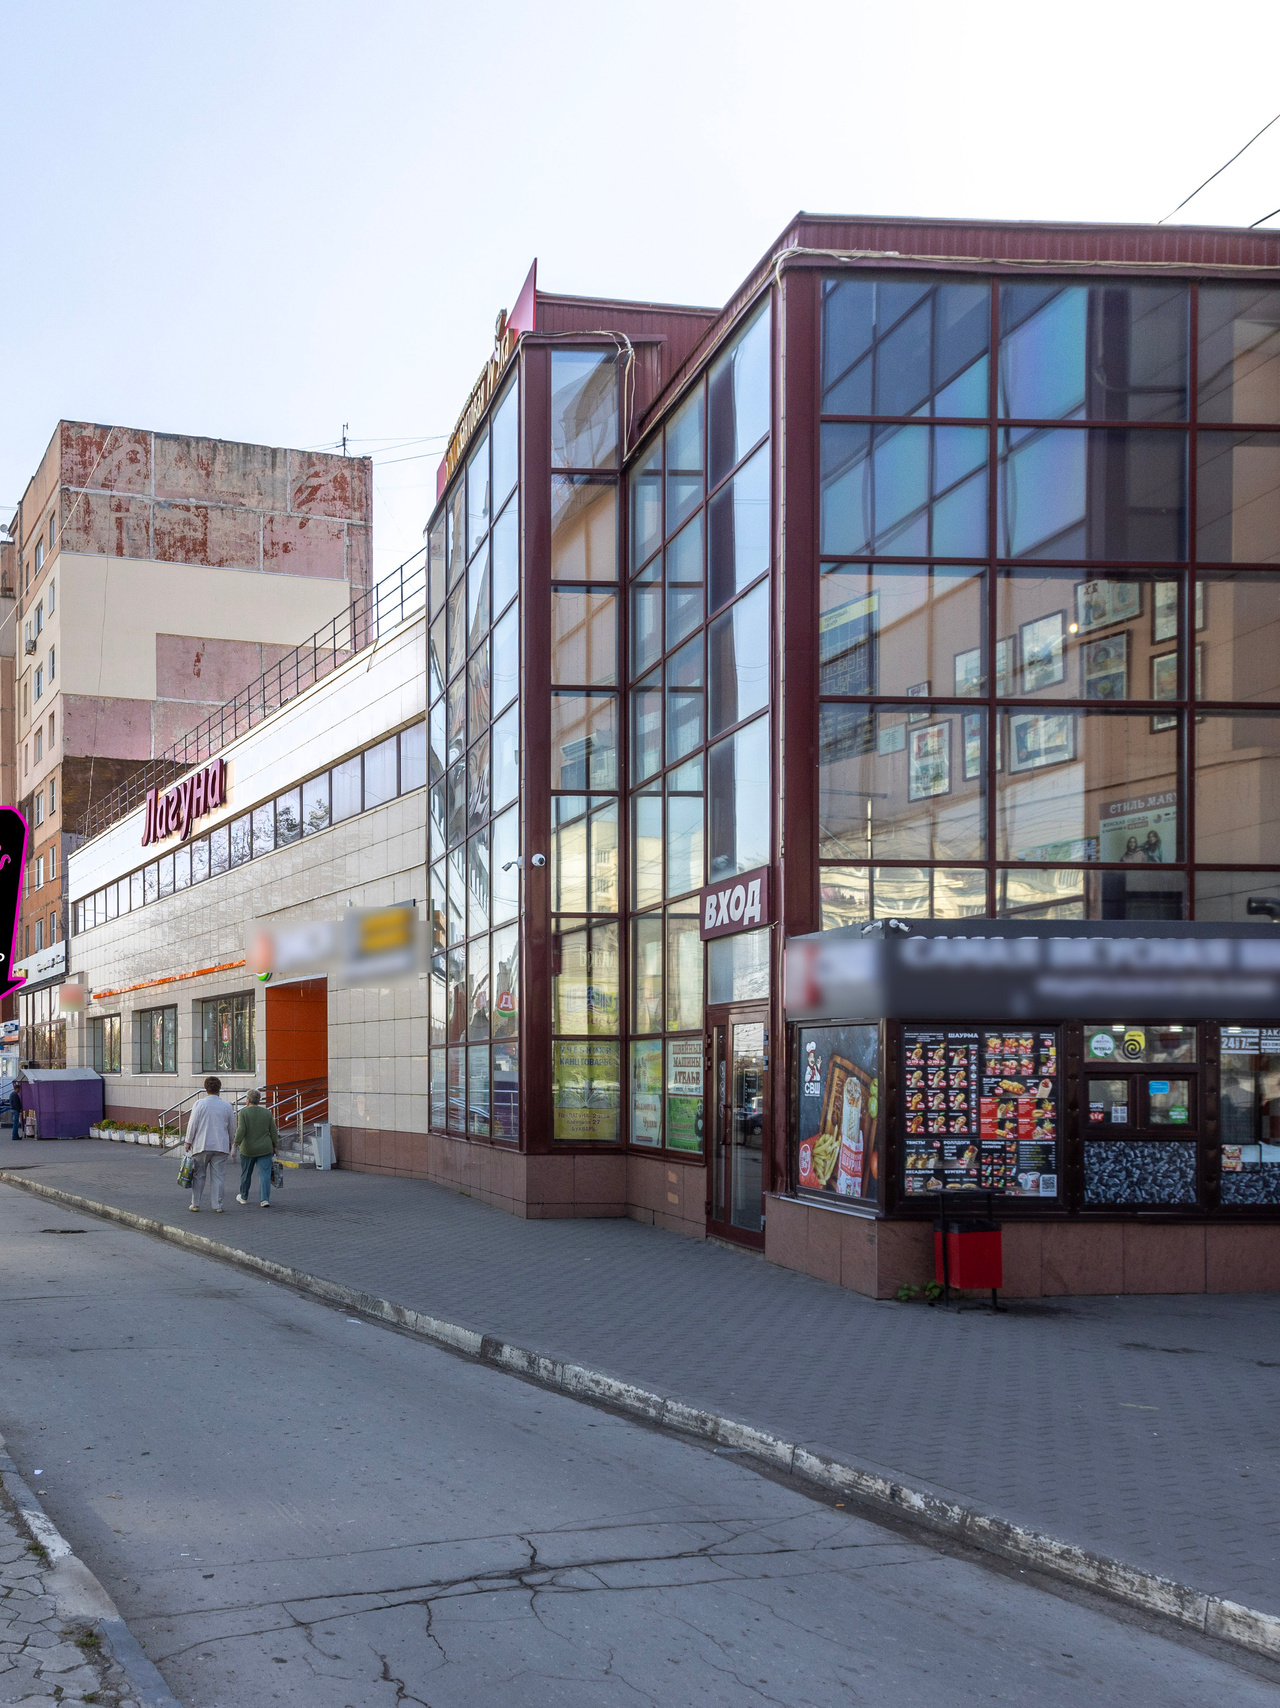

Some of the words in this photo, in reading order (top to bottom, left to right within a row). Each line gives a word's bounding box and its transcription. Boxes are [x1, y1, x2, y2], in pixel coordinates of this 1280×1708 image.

[141, 758, 225, 847] Лагуна
[1109, 799, 1145, 814] СТИЛЬ
[704, 878, 761, 930] ВХОД
[672, 1042, 702, 1055] ШВЕЙНЫЕ
[673, 1057, 702, 1068] МАШИНЫ
[674, 1071, 701, 1086] АТЕЛЬЕ
[804, 1082, 820, 1094] СВШ
